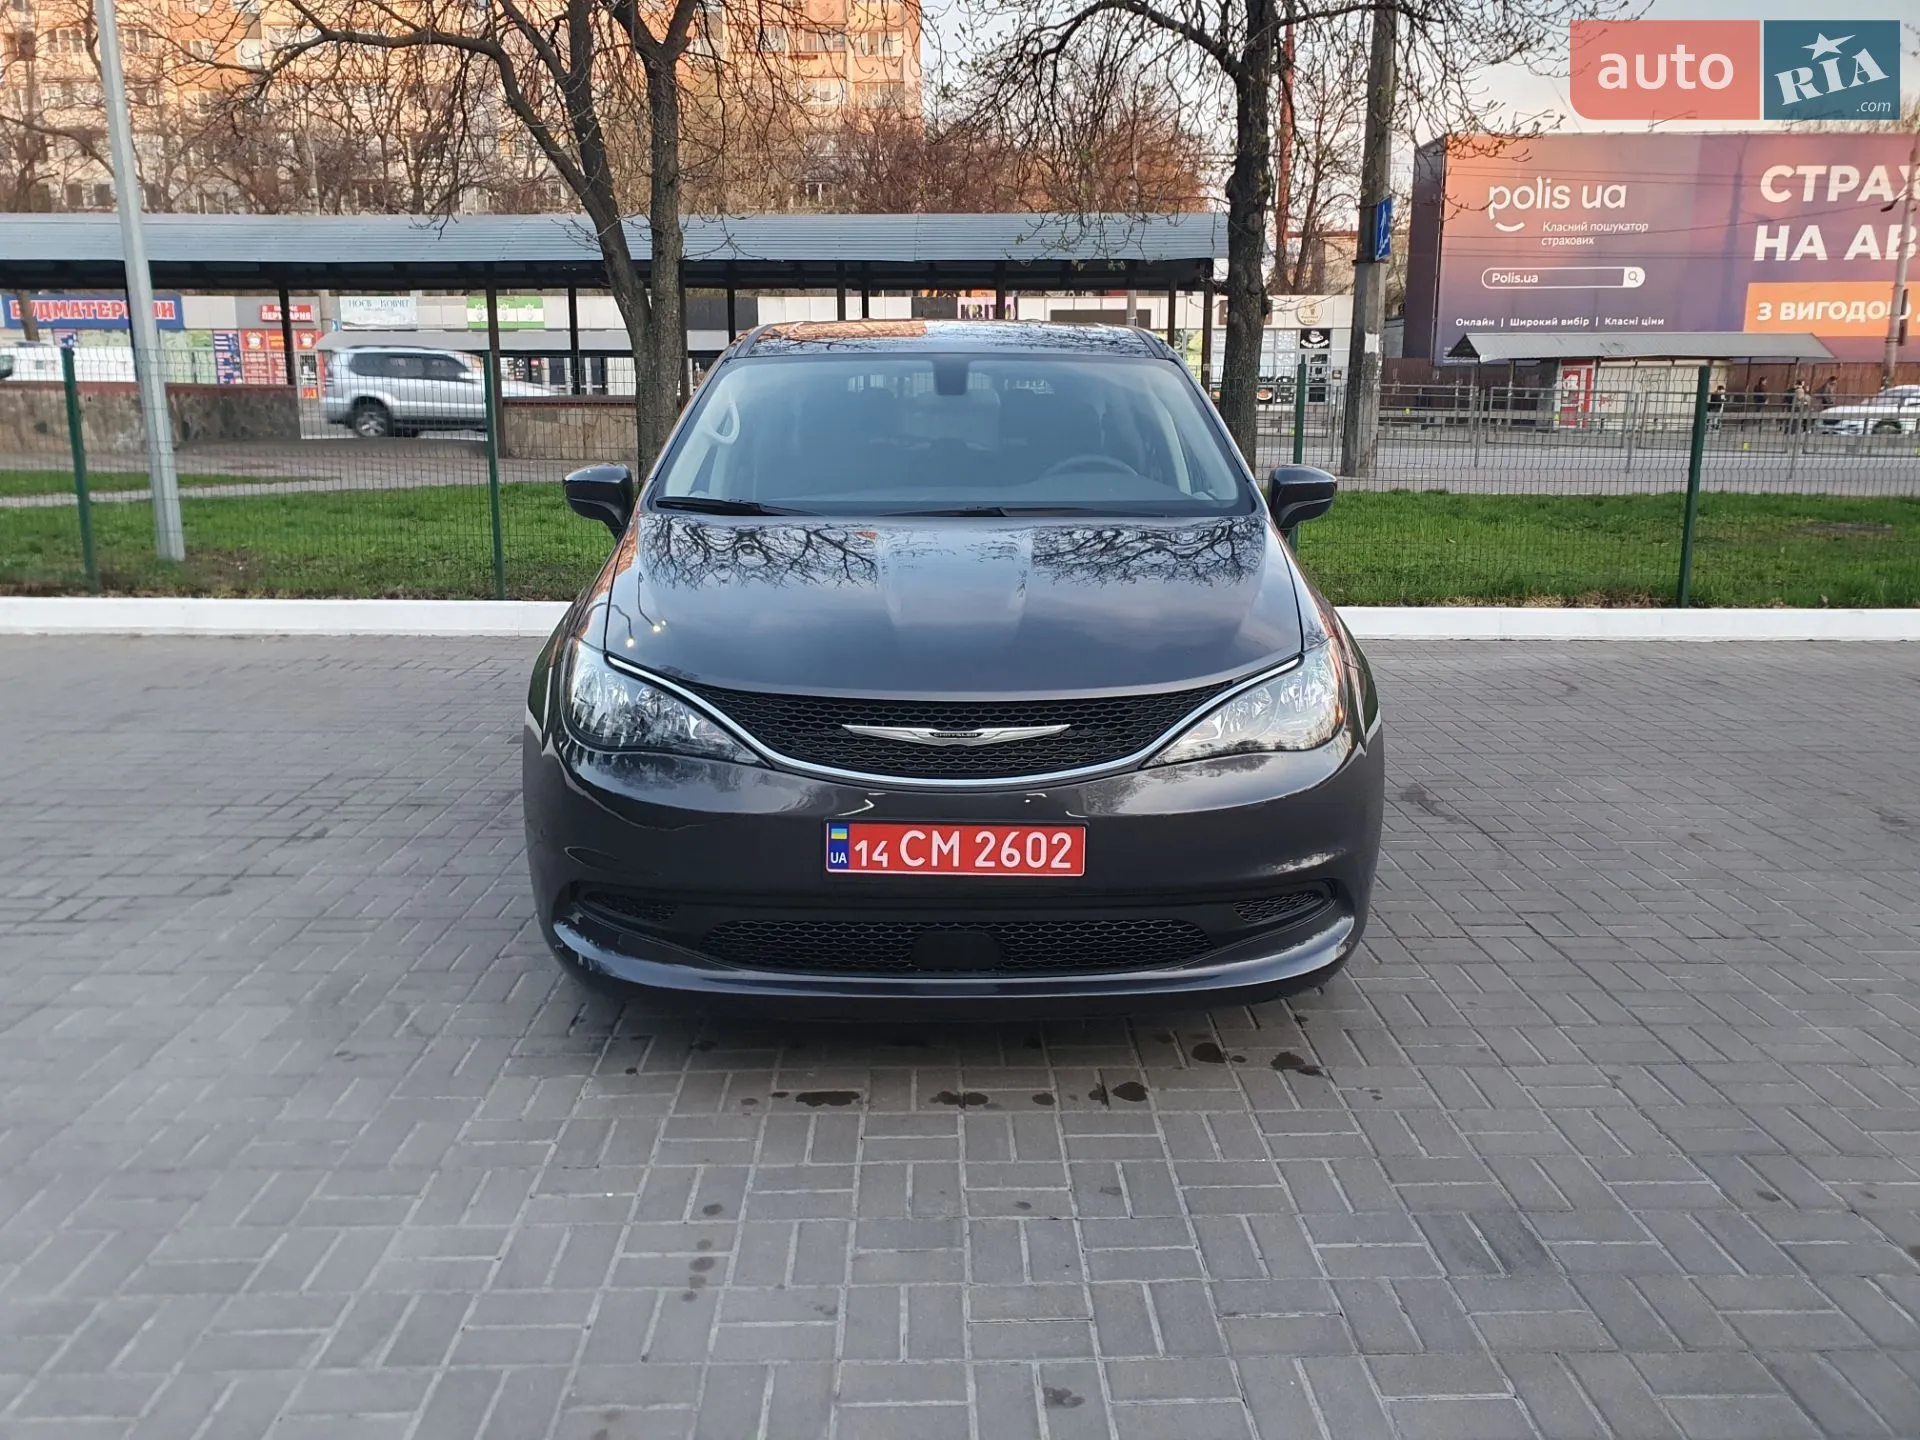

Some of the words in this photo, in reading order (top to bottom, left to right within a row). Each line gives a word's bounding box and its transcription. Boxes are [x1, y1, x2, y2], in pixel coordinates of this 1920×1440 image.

[1488, 175, 1571, 220] polis
[1581, 184, 1627, 209] ua
[1542, 221, 1588, 232] Класний
[1589, 221, 1649, 233] пошукатор
[1541, 235, 1595, 247] страхових
[1753, 224, 1829, 262] НА
[1491, 272, 1539, 285] Polis.ua
[1455, 316, 1495, 327] Онлайн
[1509, 316, 1558, 328] Широкий
[1561, 317, 1590, 328] вибір
[1604, 316, 1639, 327] Класні
[1641, 317, 1665, 328] ціни
[854, 839, 889, 868] 14
[899, 830, 960, 868] CM
[974, 831, 1073, 869] 2602
[830, 852, 847, 864] UA
